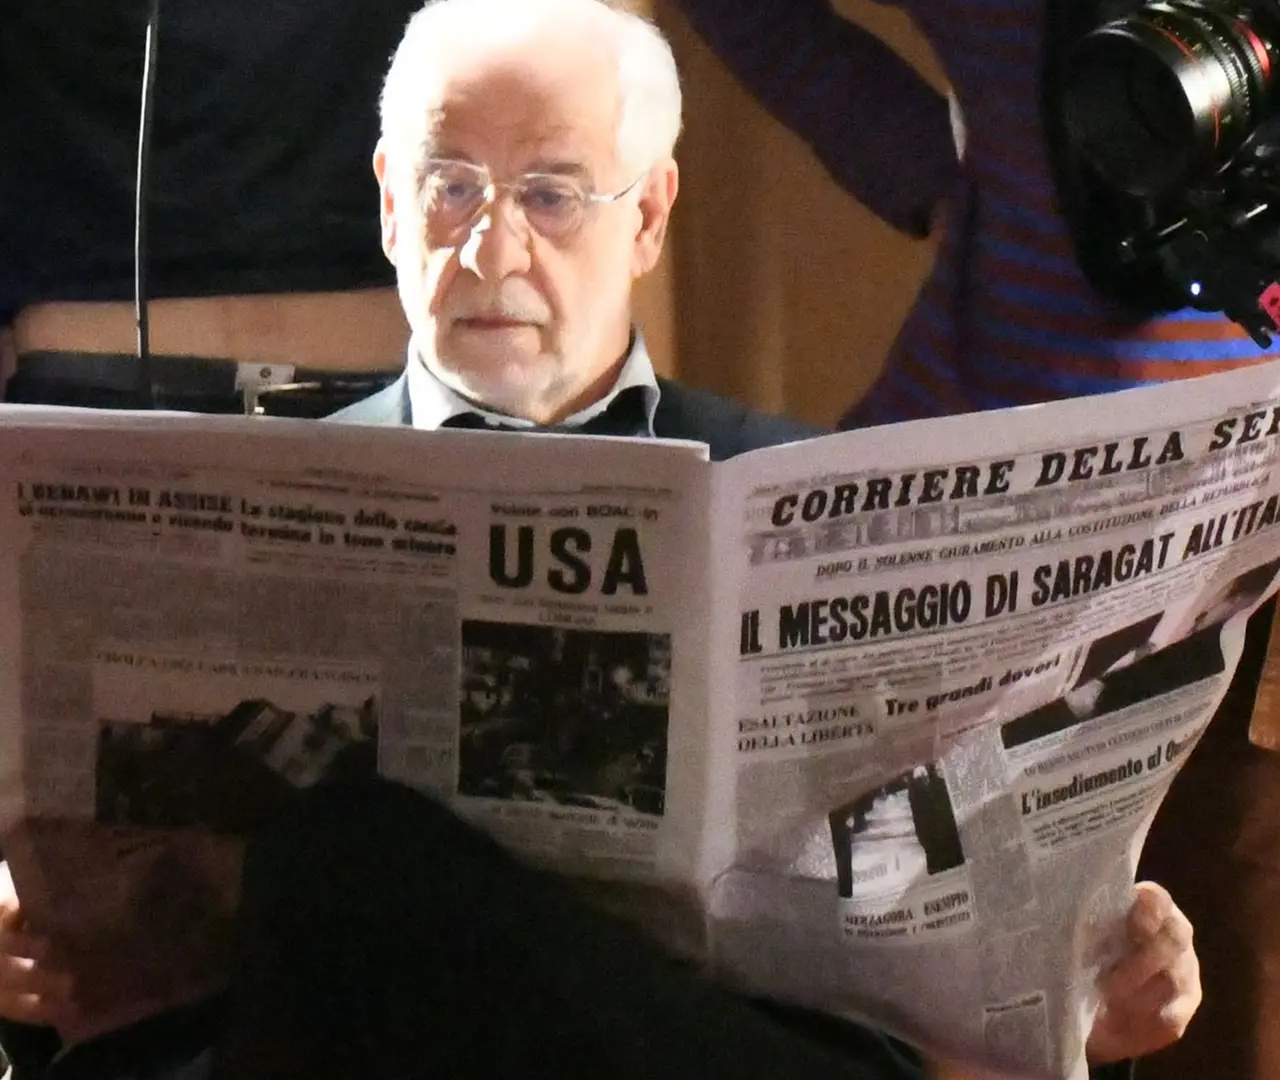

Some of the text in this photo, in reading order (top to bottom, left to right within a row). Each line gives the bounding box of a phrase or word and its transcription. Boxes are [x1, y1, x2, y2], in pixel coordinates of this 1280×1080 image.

[771, 458, 1015, 527] CORRIERE
[1035, 430, 1186, 489] DELLA
[353, 507, 398, 530] della
[815, 561, 852, 578] DOPO
[874, 548, 934, 570] SOLENNE
[938, 534, 1026, 560] GIURAMENTO
[1030, 529, 1063, 548] ALLA
[1159, 497, 1197, 519] DELLA
[488, 523, 648, 595] USA
[740, 610, 762, 655] IL
[778, 579, 972, 650] MESSAGGIO
[985, 573, 1018, 615] DI
[1031, 531, 1175, 604] SARAGAT
[737, 703, 861, 733] ESALTAZIONE
[884, 698, 920, 717] Tre
[925, 675, 994, 712] grandi
[998, 655, 1062, 687] doveri
[737, 731, 796, 753] DELLA
[1021, 758, 1144, 815] L'insediamento
[1147, 746, 1162, 770] al
